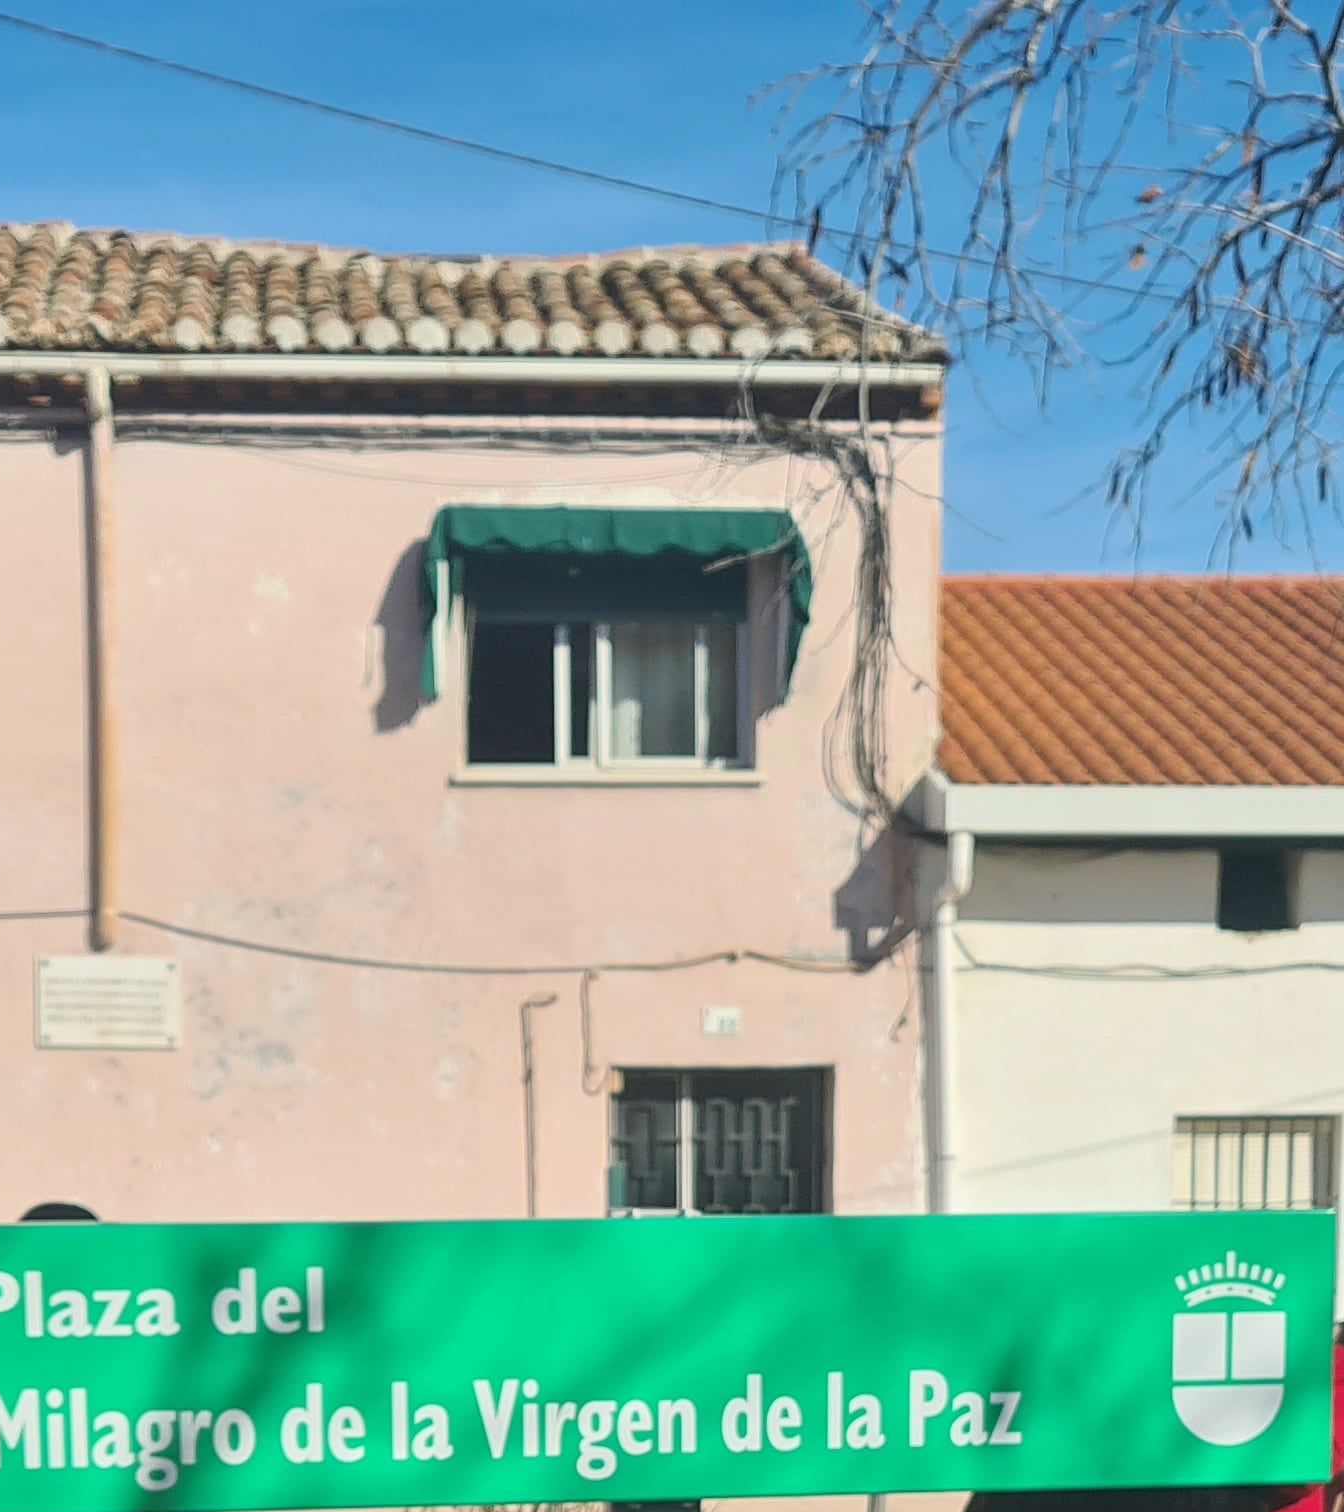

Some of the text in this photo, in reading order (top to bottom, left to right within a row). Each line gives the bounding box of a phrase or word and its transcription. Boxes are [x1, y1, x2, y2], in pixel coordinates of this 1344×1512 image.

[211, 1266, 324, 1335] del
[280, 1382, 367, 1465] de
[390, 1380, 455, 1462] la
[472, 1377, 698, 1482] Virgen
[720, 1372, 804, 1454] de
[826, 1370, 887, 1452] la
[908, 1368, 1023, 1449] Paz
